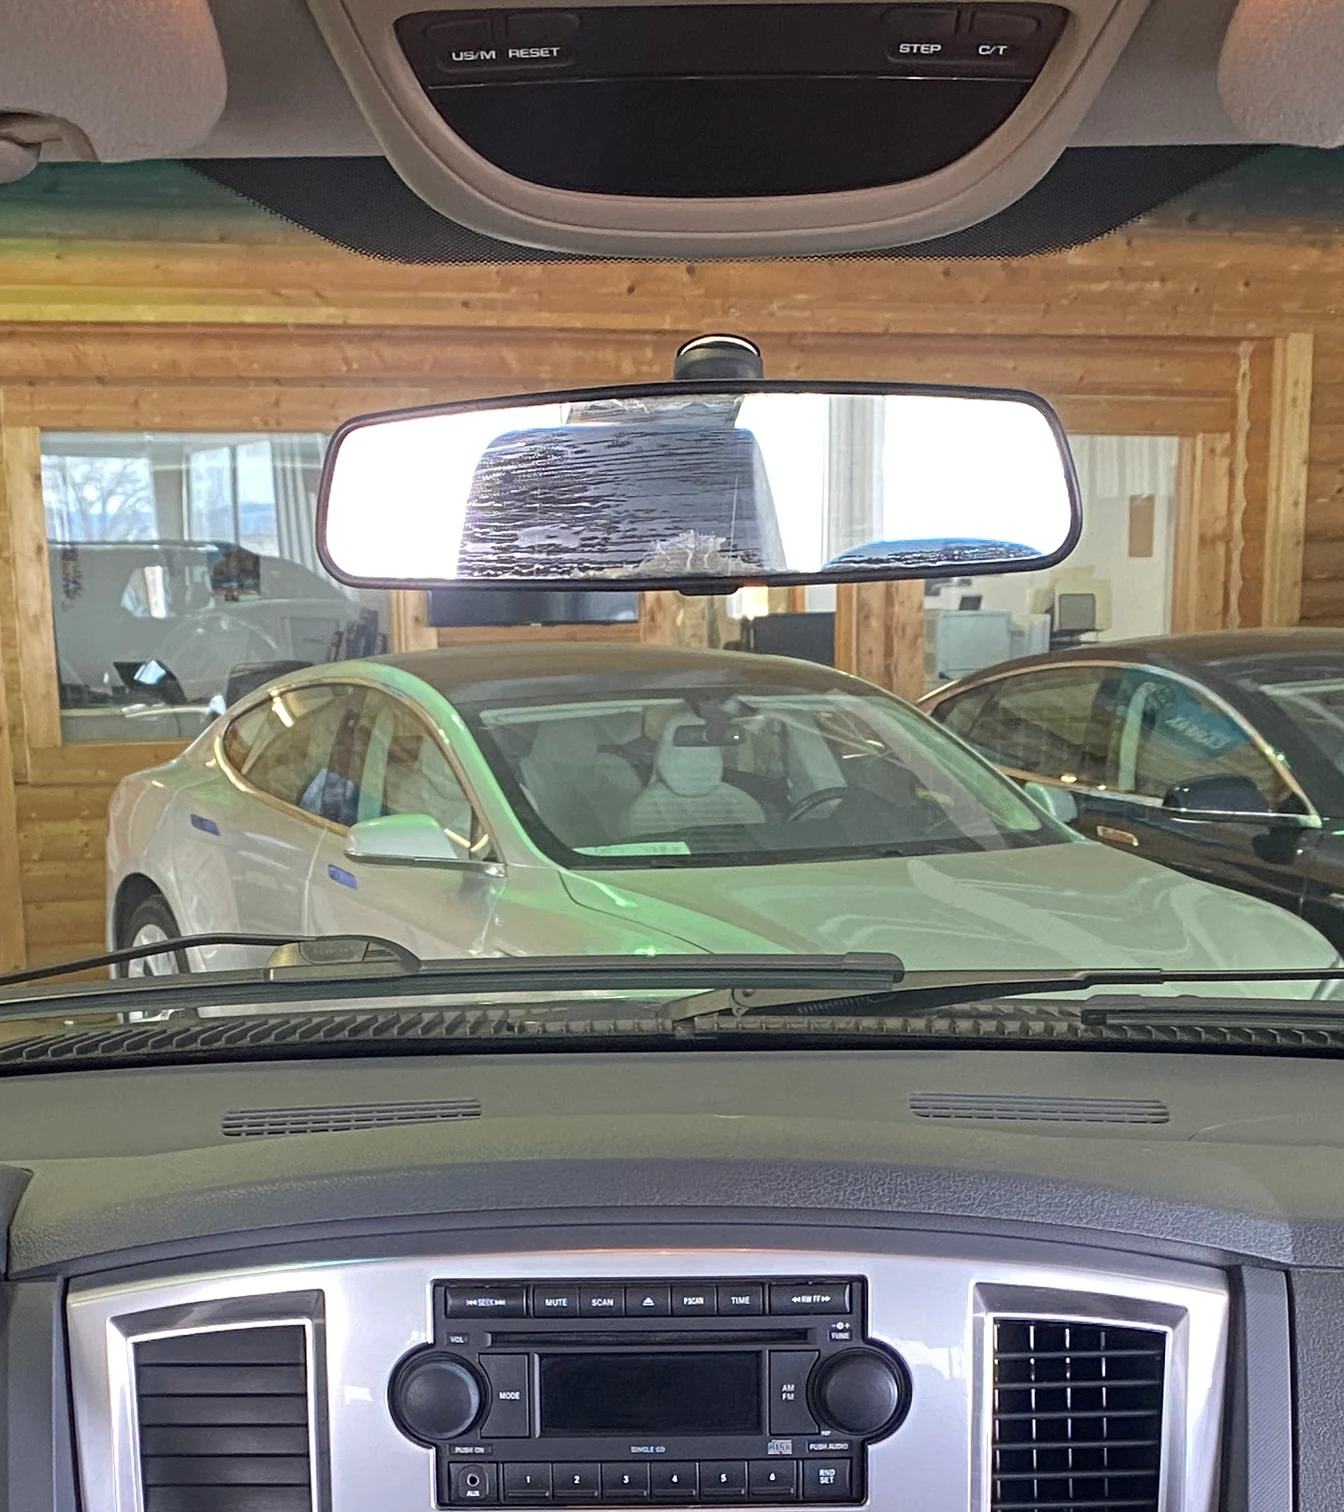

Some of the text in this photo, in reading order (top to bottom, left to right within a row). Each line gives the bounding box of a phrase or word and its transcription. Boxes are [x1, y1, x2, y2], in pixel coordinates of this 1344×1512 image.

[899, 43, 1008, 55] STEP C/T
[451, 47, 561, 61] US/M RESET
[477, 1298, 494, 1307] SEEK
[545, 1298, 568, 1307] MUTE
[591, 1298, 614, 1307] SCAN
[731, 1296, 750, 1305] TIME
[450, 1336, 464, 1344] VOL
[831, 1332, 850, 1340] TUNE
[781, 1384, 795, 1392] AM
[499, 1391, 520, 1400] MODE
[782, 1392, 795, 1400] FM
[573, 1475, 580, 1484] 2
[622, 1475, 629, 1484] 3
[671, 1474, 678, 1483] 4
[720, 1474, 727, 1483] 5
[769, 1472, 776, 1481] 6
[819, 1476, 834, 1484] SET
